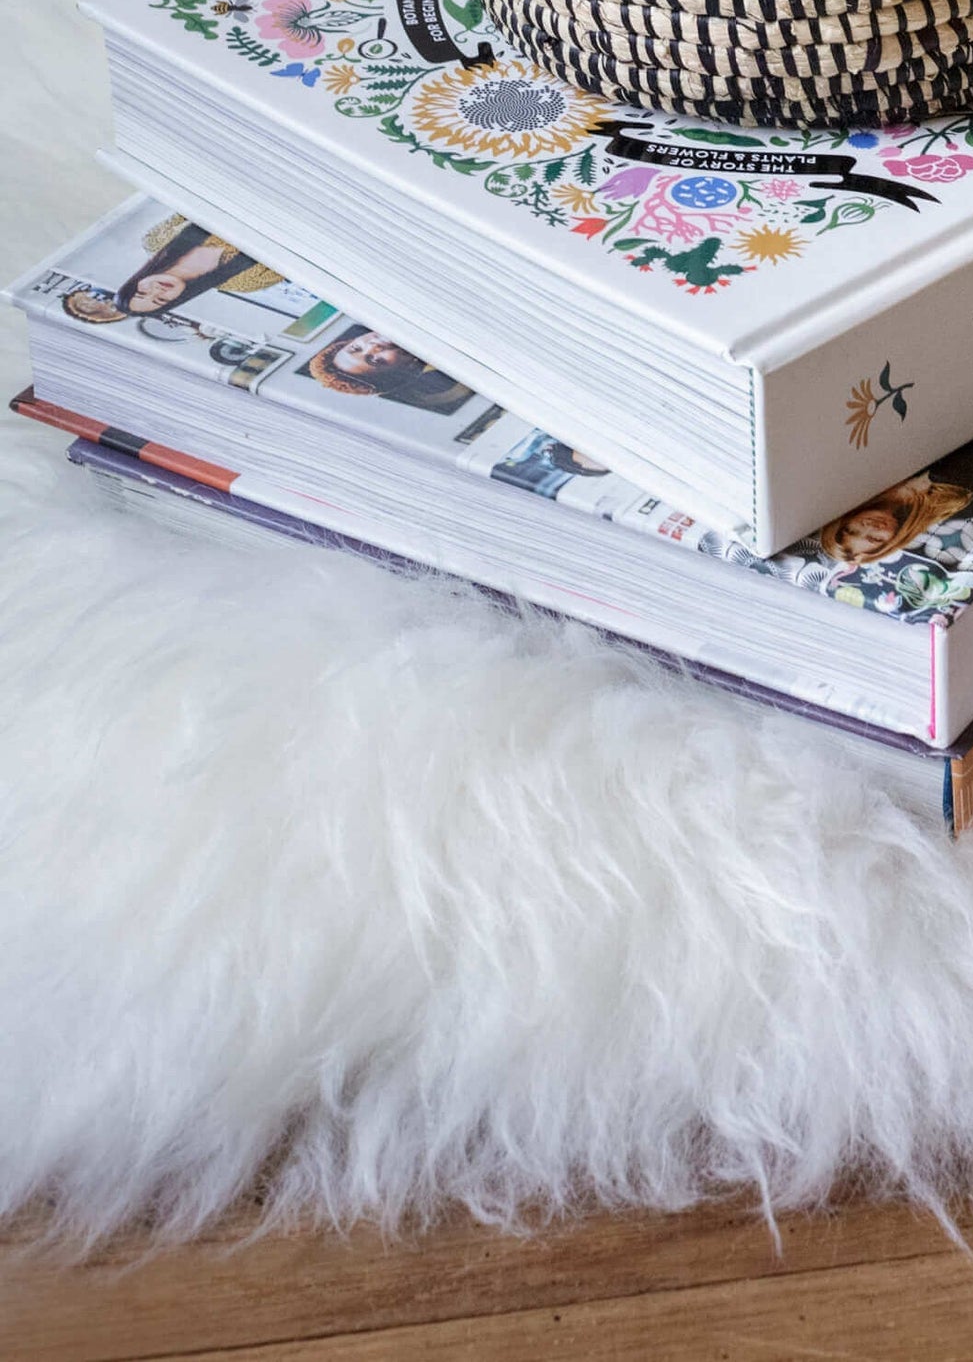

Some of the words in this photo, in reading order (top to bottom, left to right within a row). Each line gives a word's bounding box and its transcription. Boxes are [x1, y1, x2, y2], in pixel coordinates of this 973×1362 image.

[426, 23, 447, 43] FOR
[646, 143, 729, 161] FLOWERS
[734, 152, 744, 163] &
[669, 157, 695, 167] OF
[750, 154, 817, 165] PLANTS
[699, 161, 756, 172] STORY
[760, 164, 796, 174] THE
